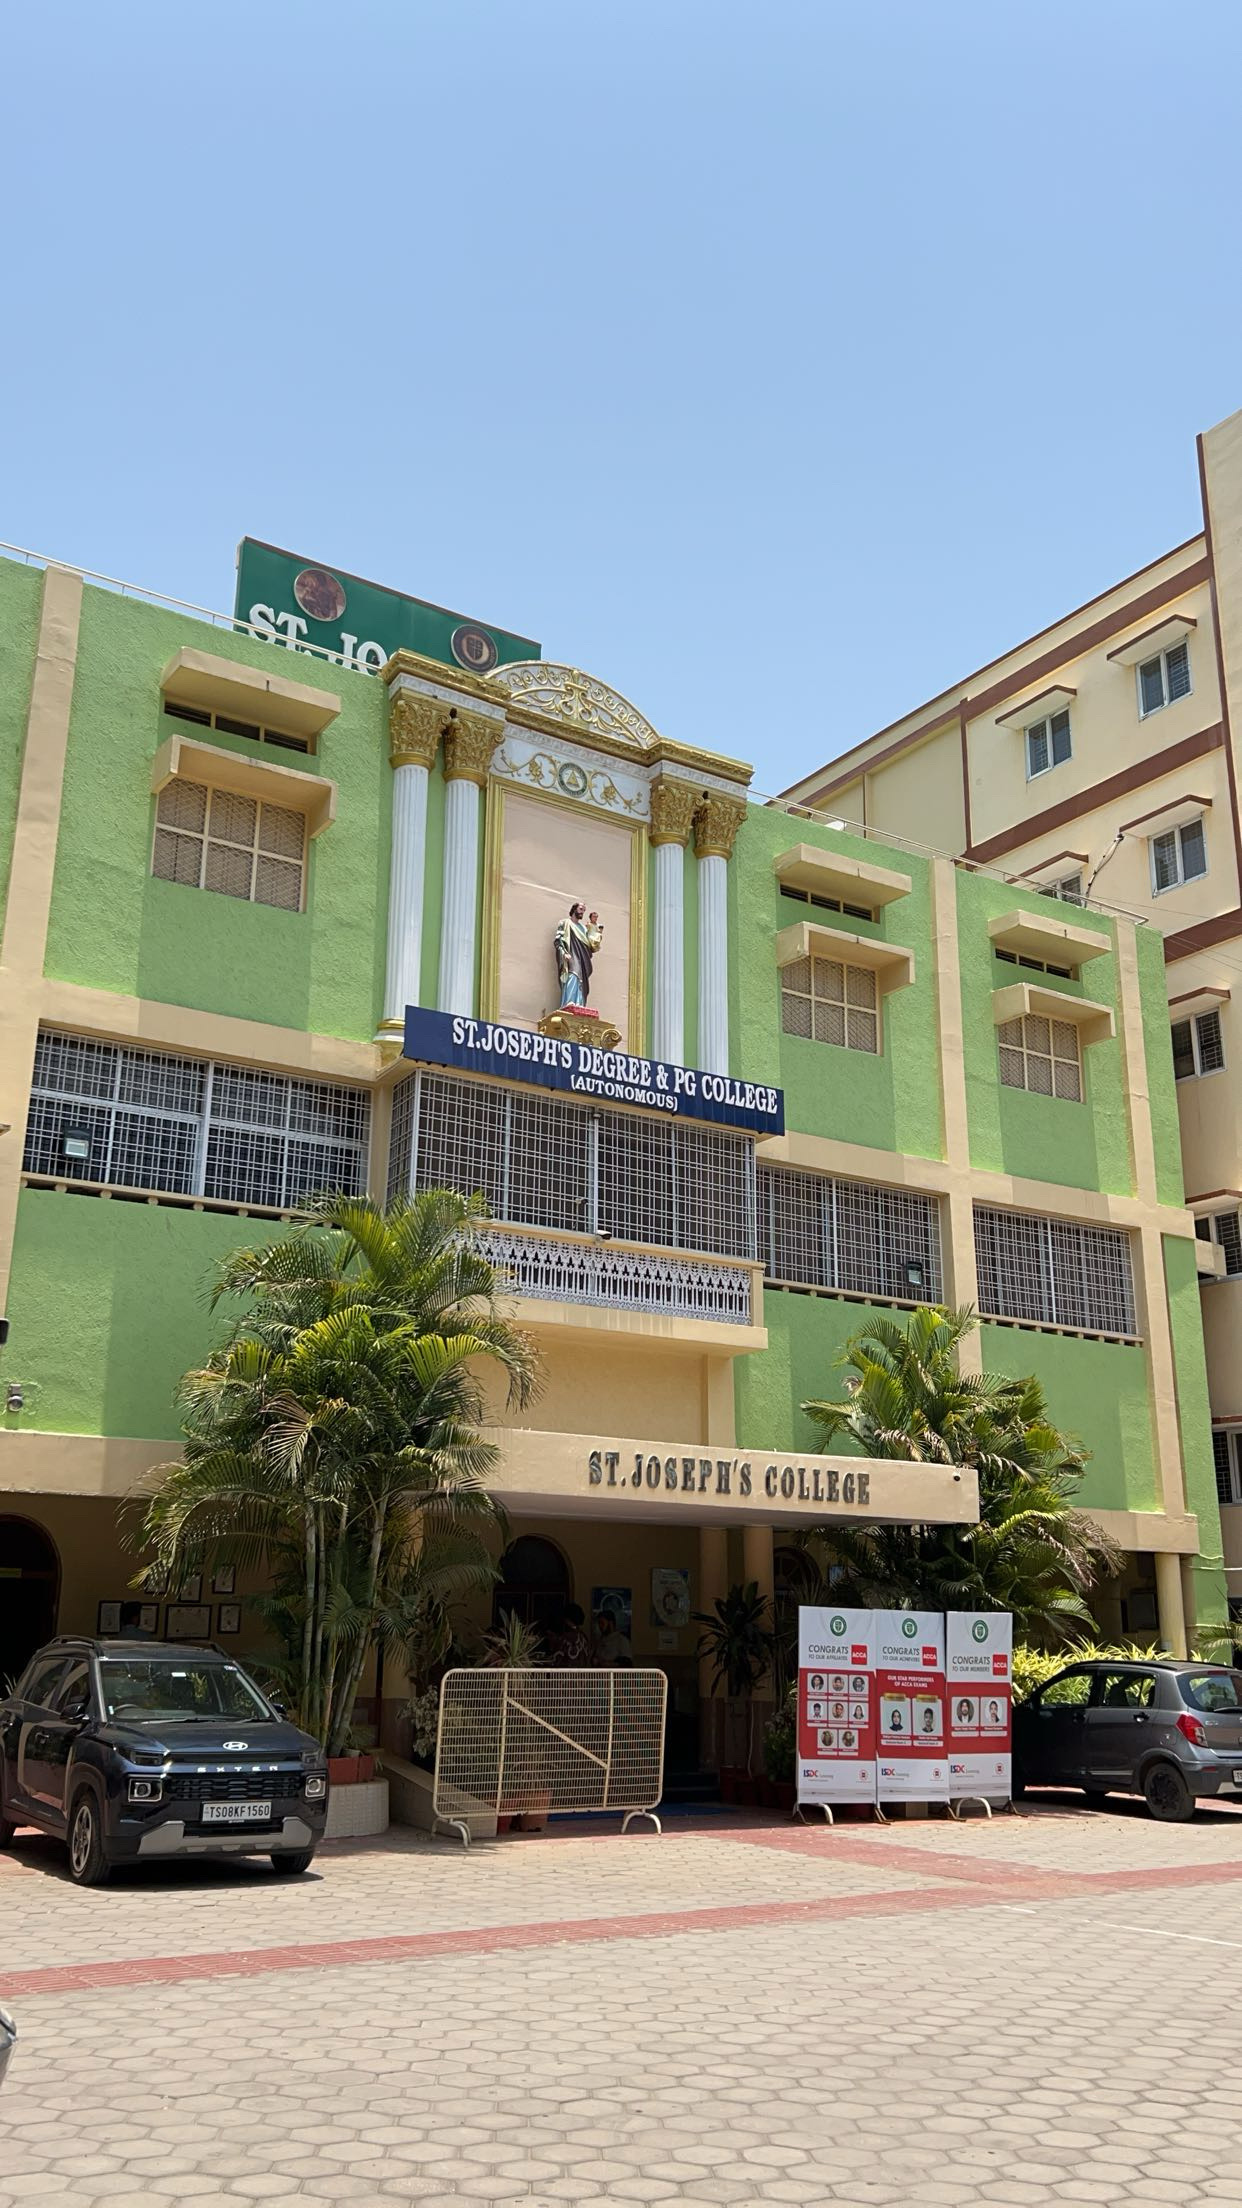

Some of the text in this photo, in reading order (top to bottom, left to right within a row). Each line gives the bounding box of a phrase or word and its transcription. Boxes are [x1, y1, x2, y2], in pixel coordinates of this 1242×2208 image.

[452, 1017, 778, 1114] ST.JOSEPH'S DEGREE & PG COLLEGE
[571, 1074, 678, 1112] (AUTONOMOUS)
[588, 1450, 870, 1505] ST.JOSEPH'S COLLEGE
[809, 1645, 848, 1654] CONGRATS
[883, 1647, 920, 1655] CONGRATS
[952, 1656, 990, 1664] CONGRATS
[197, 1765, 278, 1773] EXTER
[210, 1805, 269, 1818] TS08KF1560
